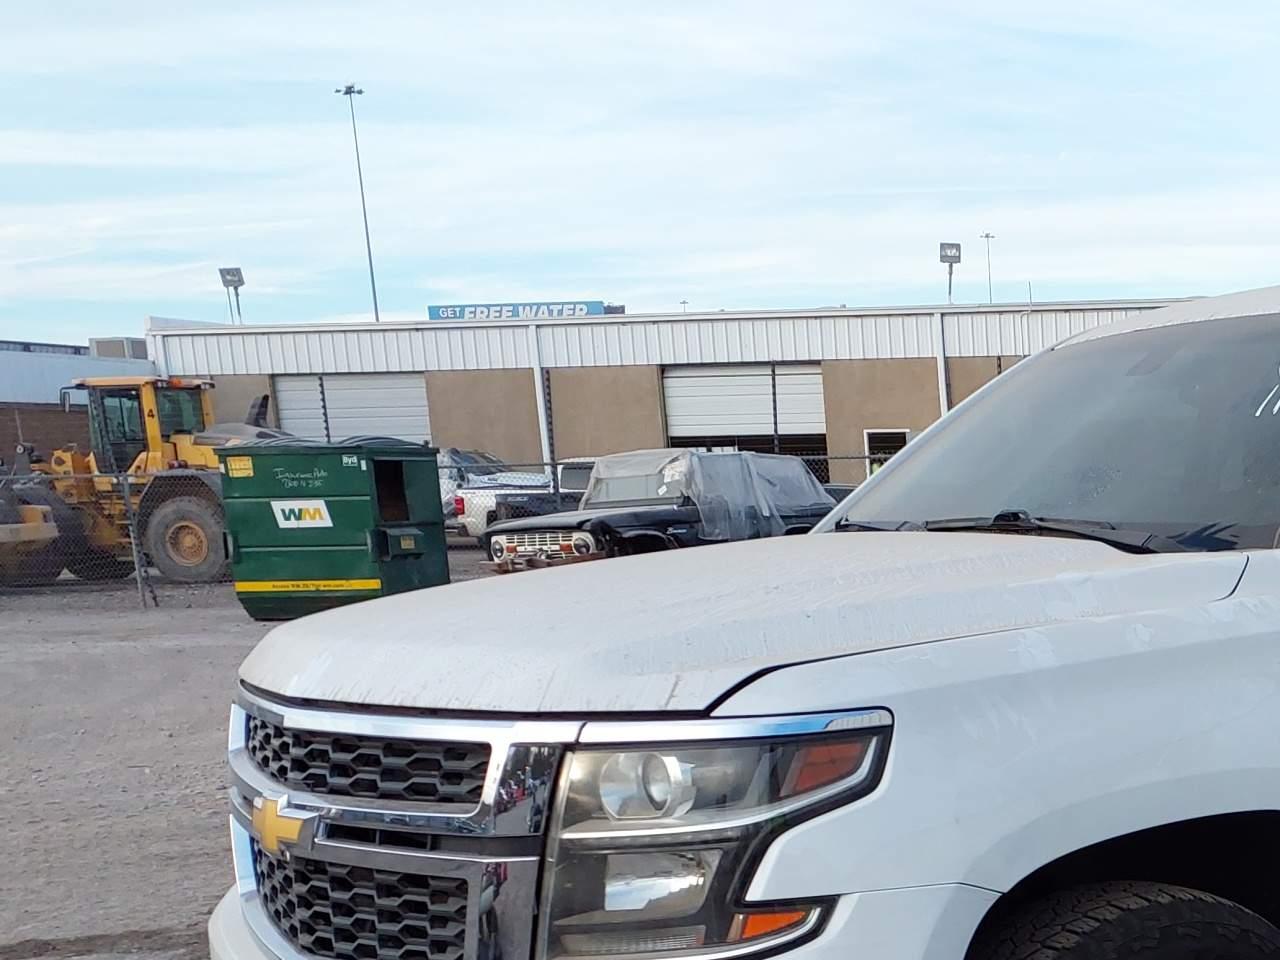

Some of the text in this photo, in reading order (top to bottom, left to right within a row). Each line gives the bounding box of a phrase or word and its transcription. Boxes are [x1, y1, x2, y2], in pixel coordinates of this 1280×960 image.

[439, 303, 588, 320] GET FREE WATER
[147, 408, 155, 419] 4
[280, 506, 325, 522] WM
